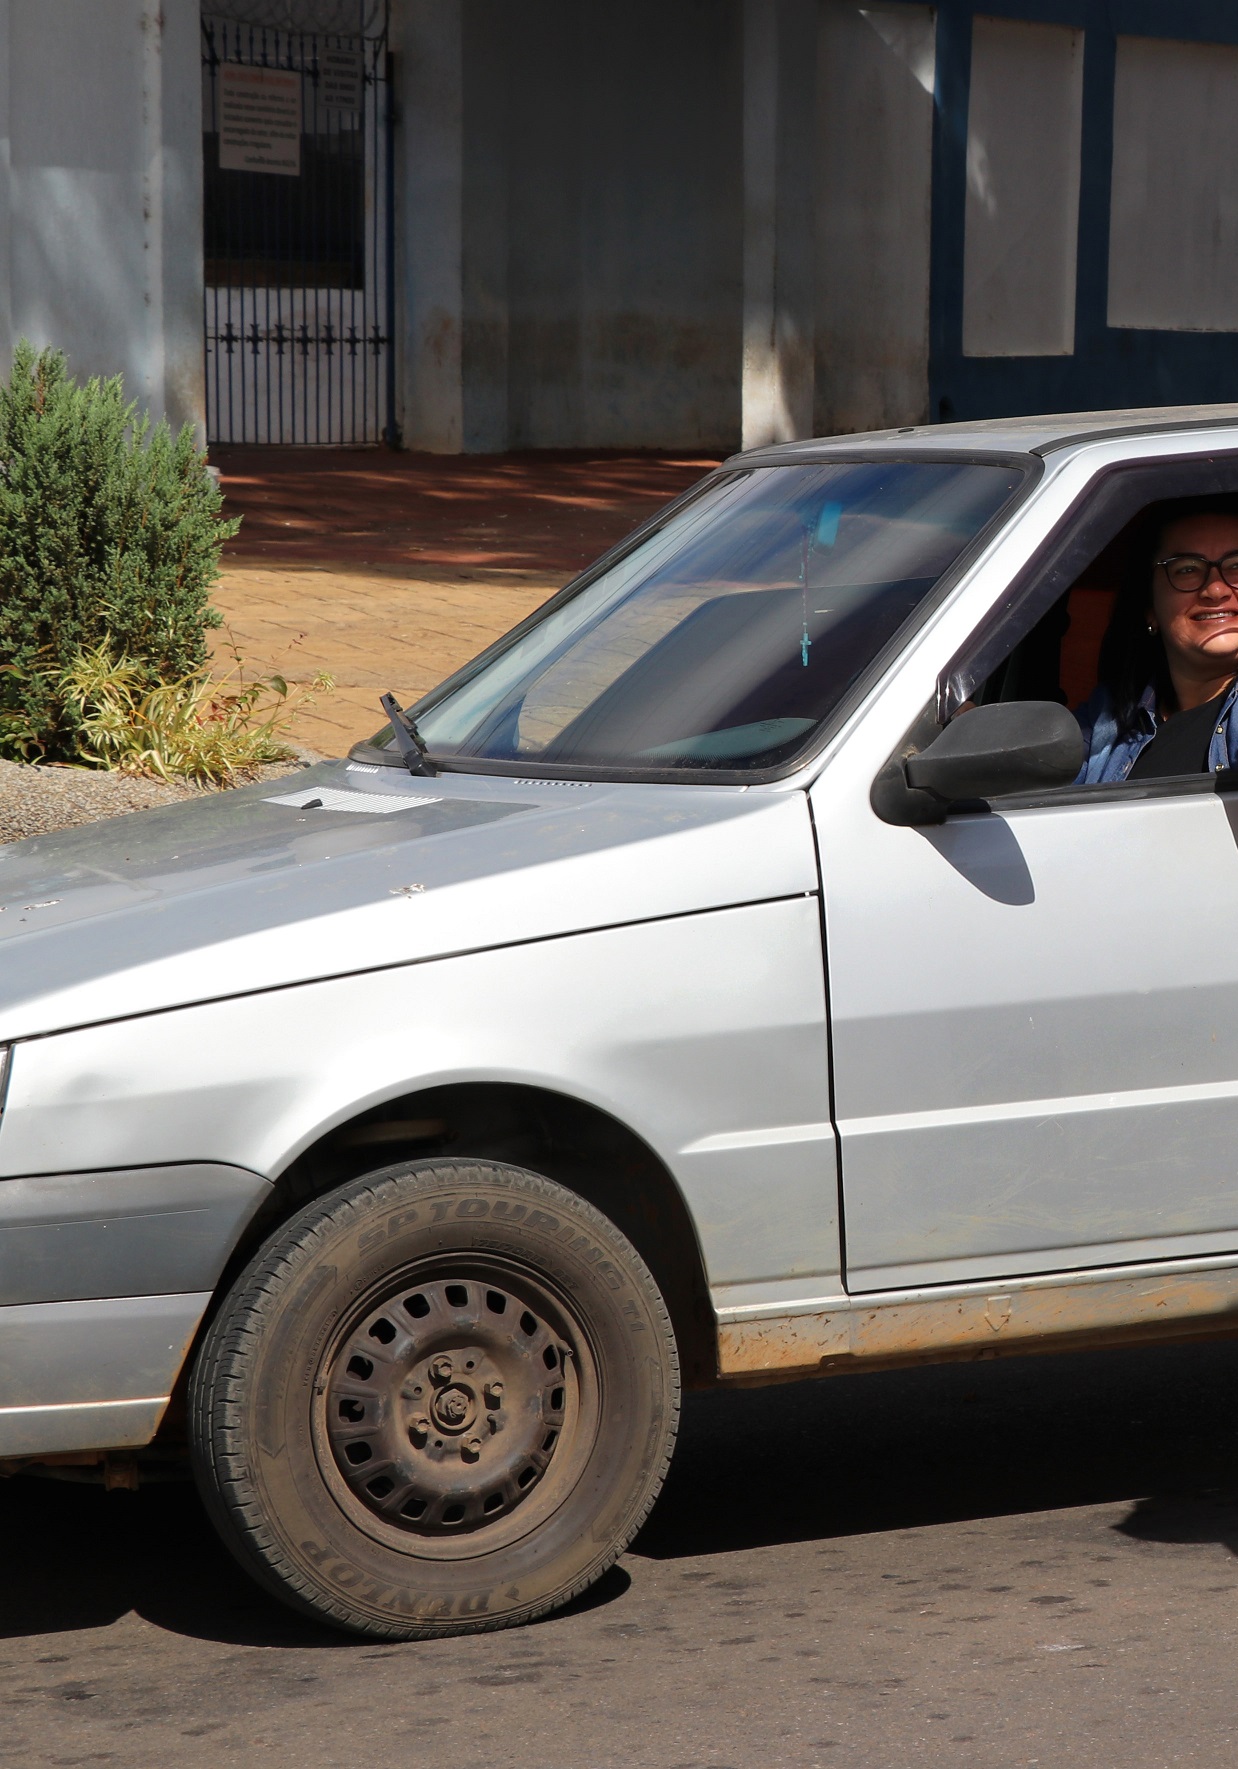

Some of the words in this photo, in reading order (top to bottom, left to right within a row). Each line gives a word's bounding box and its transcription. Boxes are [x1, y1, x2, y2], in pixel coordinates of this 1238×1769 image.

[357, 1208, 420, 1251] SP
[429, 1198, 626, 1290] TOURING
[622, 1299, 646, 1332] T1
[299, 1540, 495, 1617] DUNLOP
